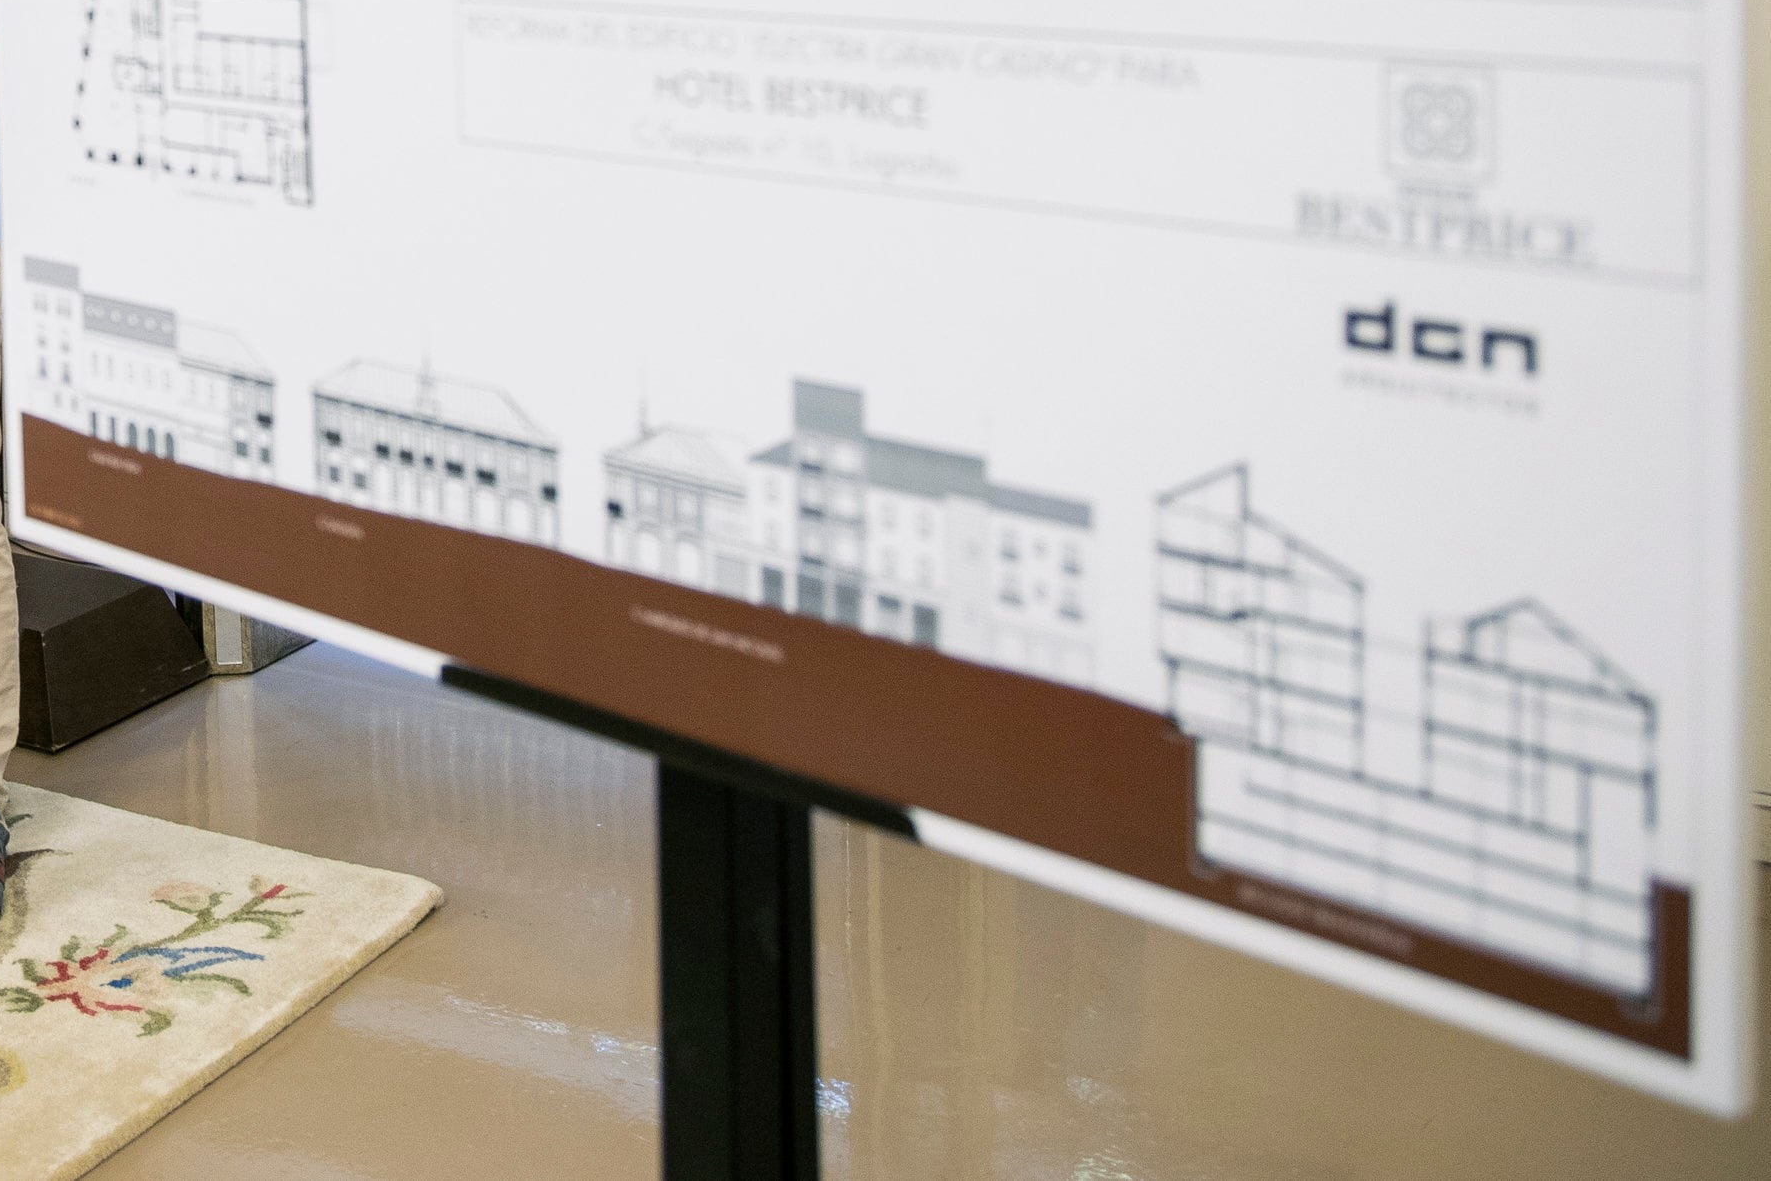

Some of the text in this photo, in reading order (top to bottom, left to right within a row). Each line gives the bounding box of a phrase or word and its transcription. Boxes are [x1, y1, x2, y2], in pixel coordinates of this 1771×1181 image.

[654, 68, 932, 130] HOTEL BESTPRICE
[1295, 192, 1595, 268] BESTPRICE
